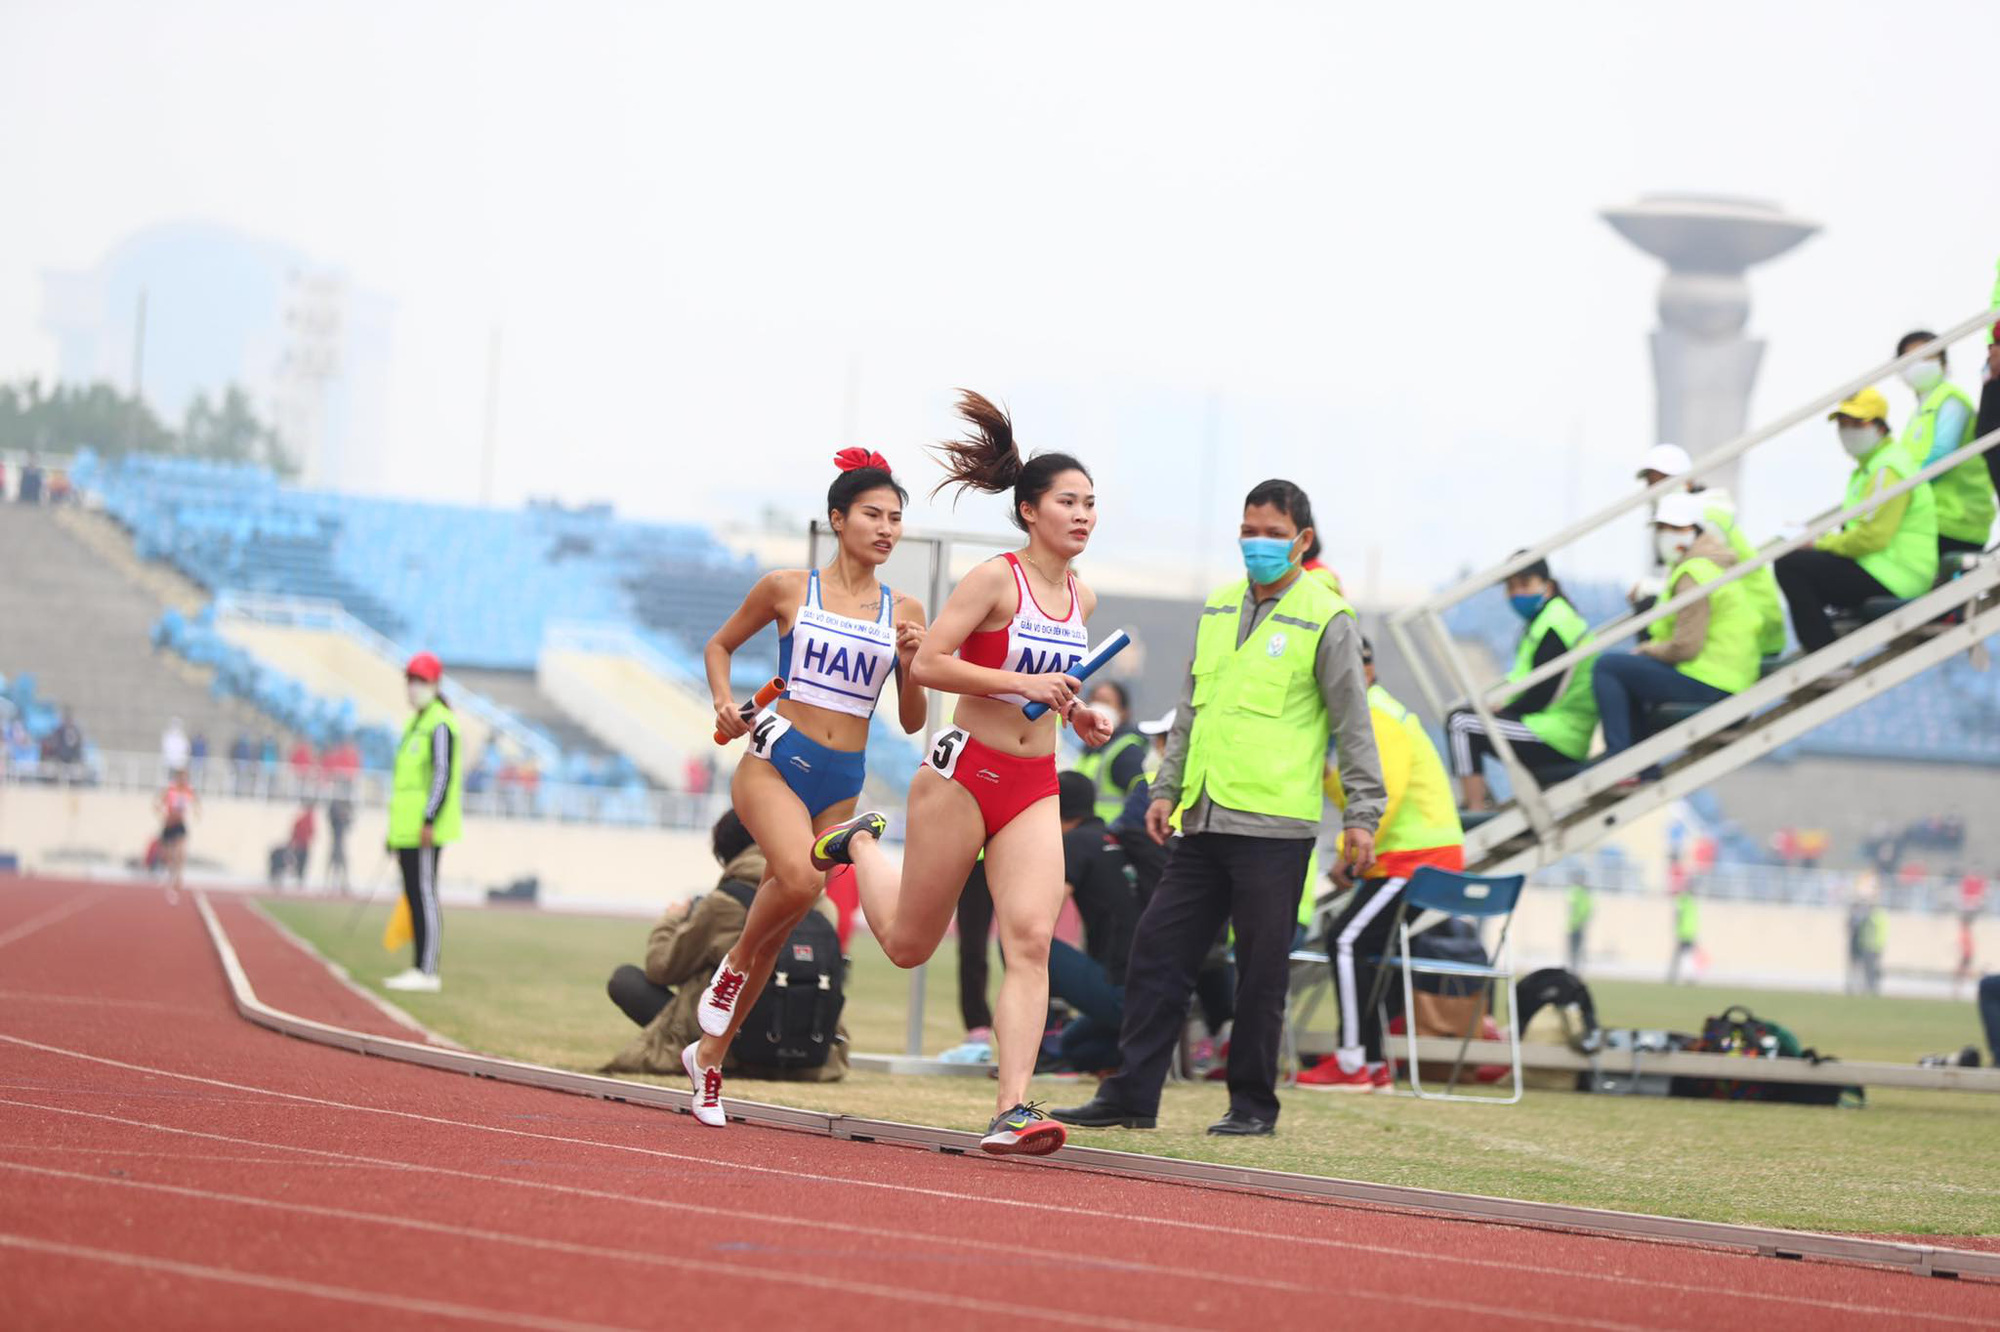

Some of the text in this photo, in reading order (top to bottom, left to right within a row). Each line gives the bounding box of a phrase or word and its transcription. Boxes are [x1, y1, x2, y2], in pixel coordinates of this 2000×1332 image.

[803, 637, 878, 687] HAN
[753, 715, 778, 754] 4
[932, 729, 963, 770] 5
